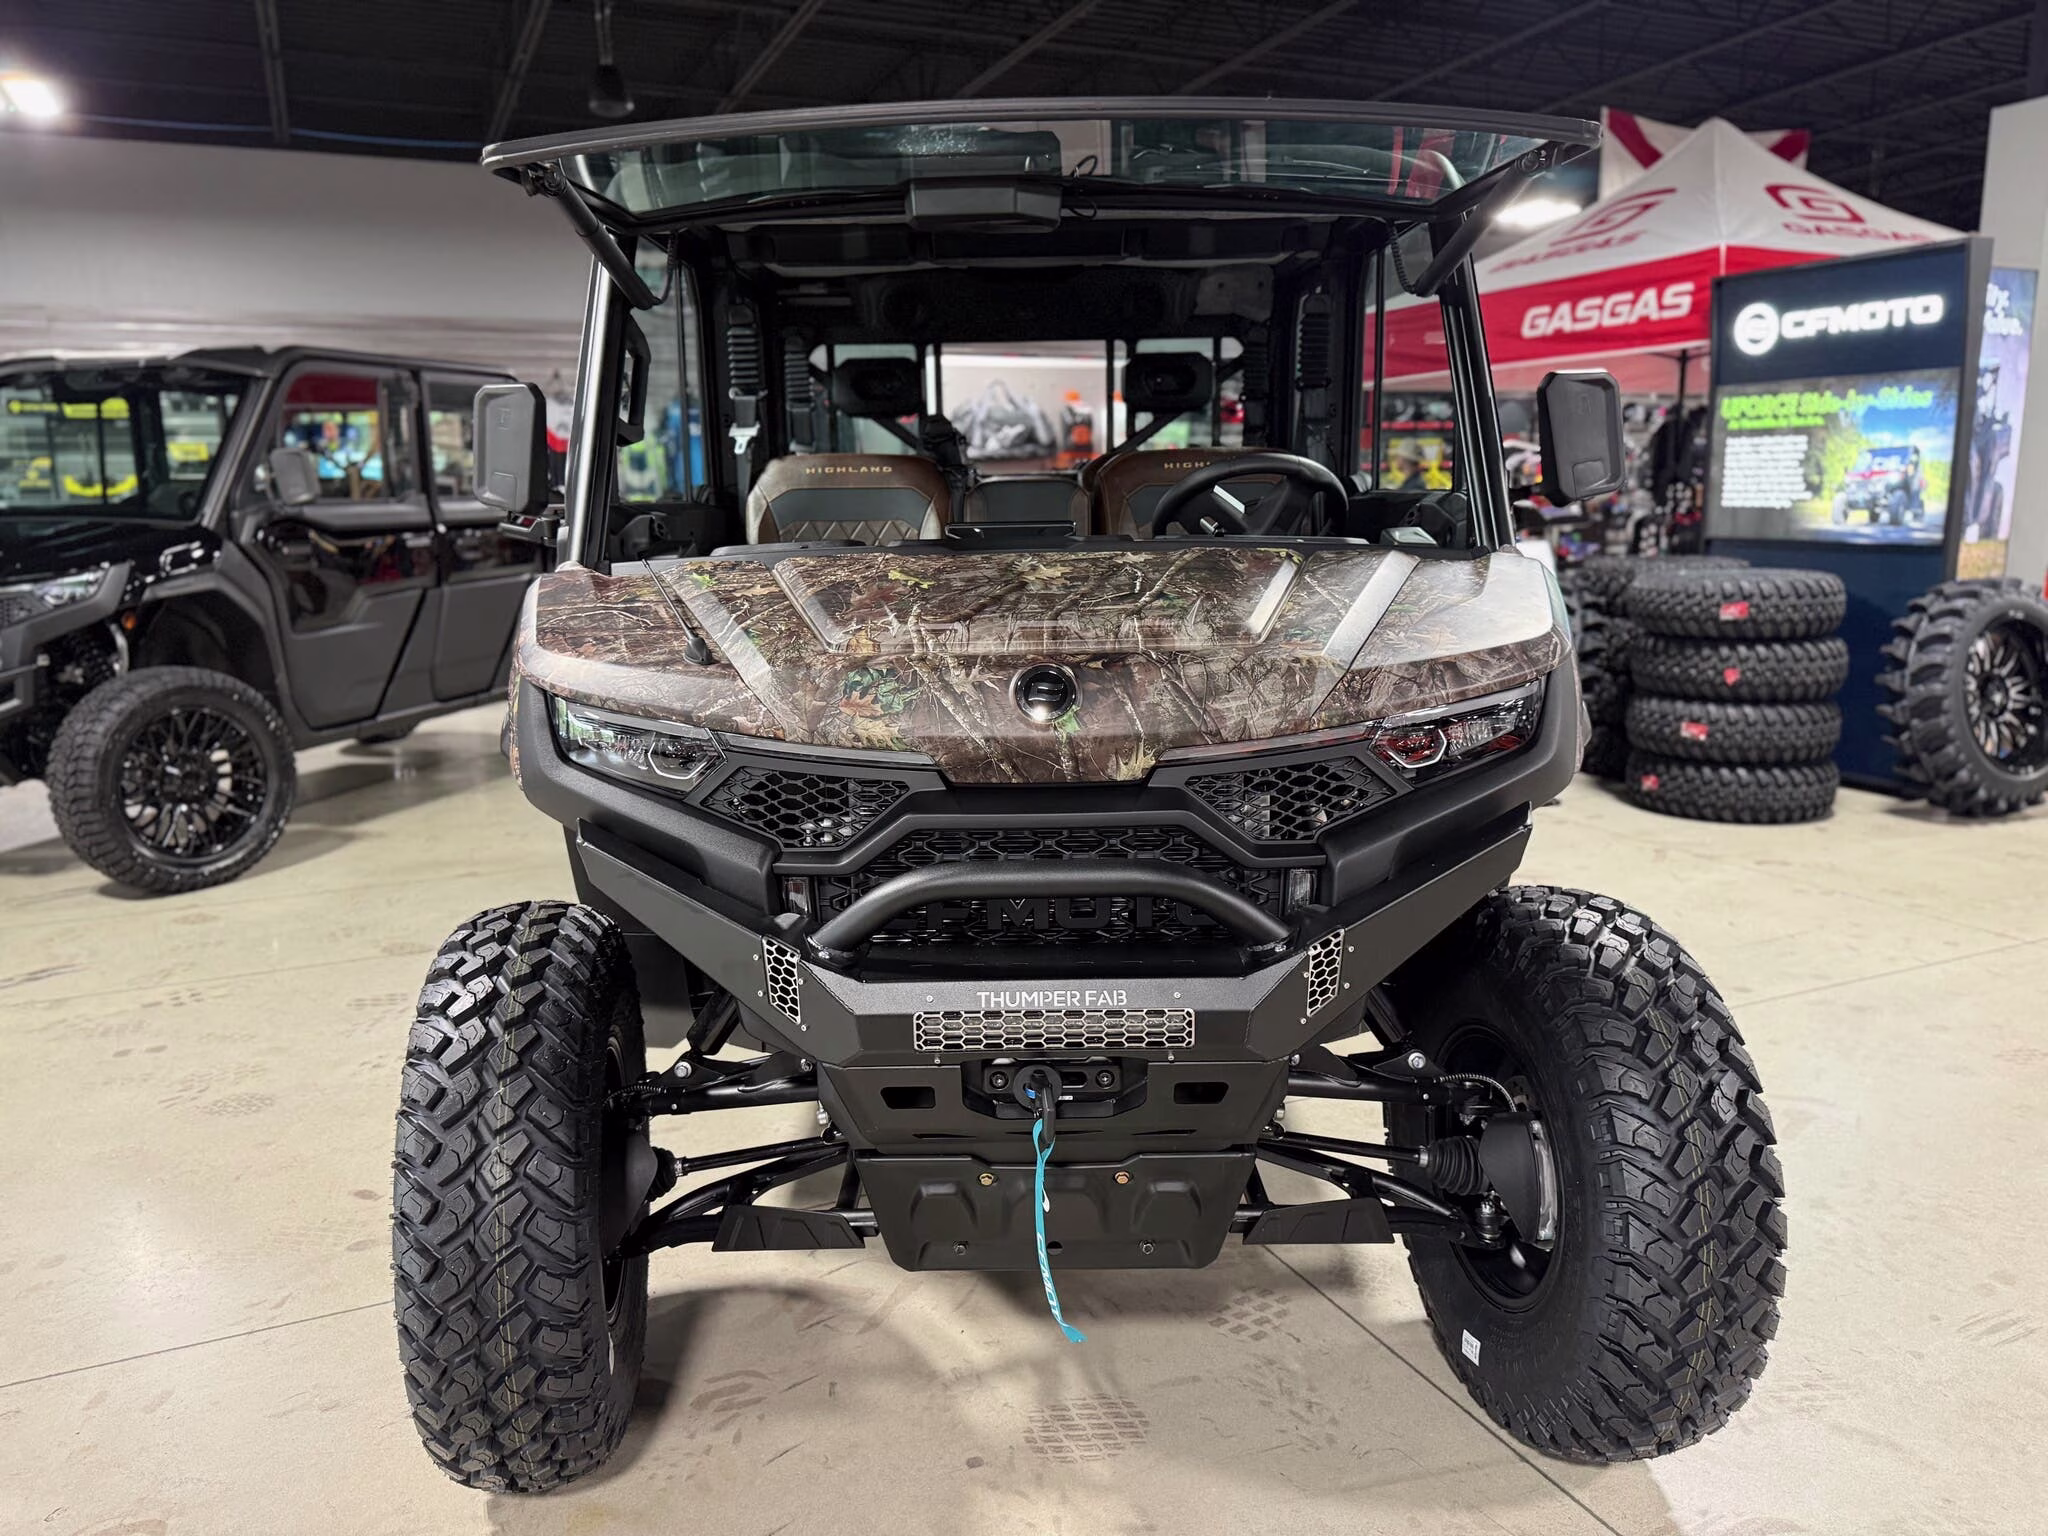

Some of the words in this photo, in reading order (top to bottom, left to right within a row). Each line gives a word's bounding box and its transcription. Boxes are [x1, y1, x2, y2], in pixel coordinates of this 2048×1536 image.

[1520, 281, 1695, 340] GASGAS
[1780, 293, 1945, 339] CFMOTO
[805, 466, 893, 475] HIGHLAND
[977, 991, 1081, 1008] THUMPER
[1085, 990, 1128, 1006] FAB
